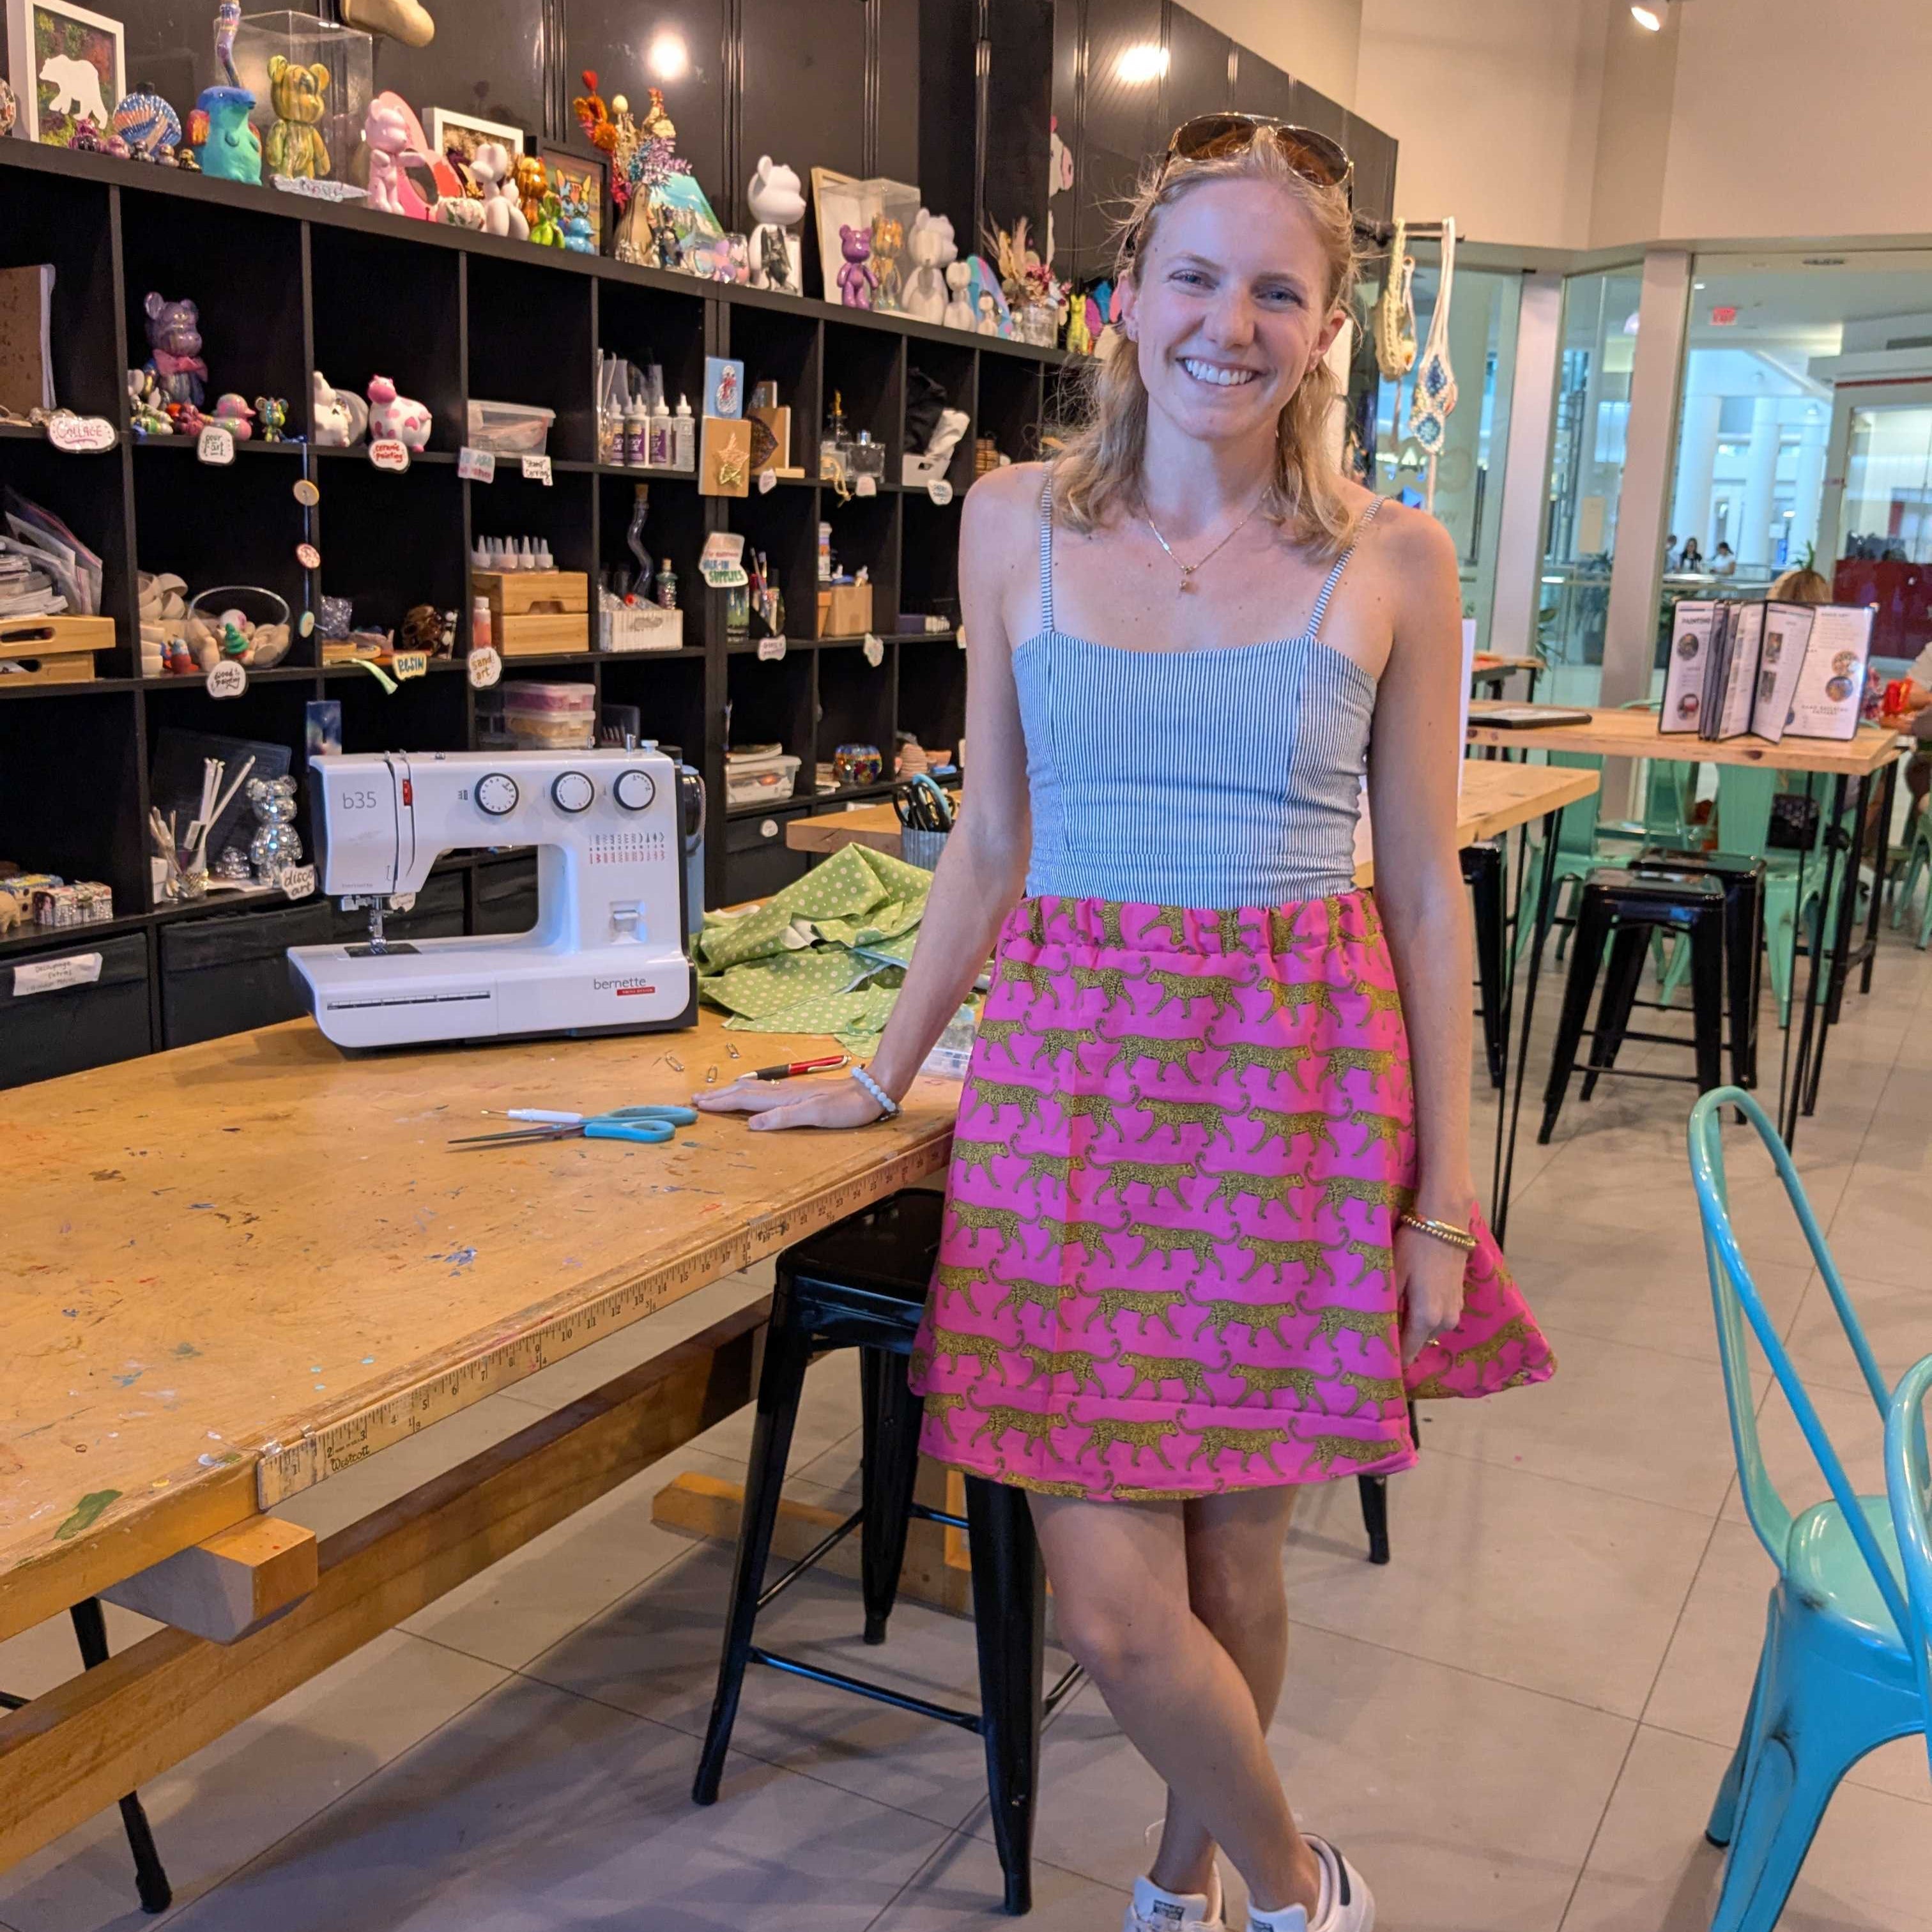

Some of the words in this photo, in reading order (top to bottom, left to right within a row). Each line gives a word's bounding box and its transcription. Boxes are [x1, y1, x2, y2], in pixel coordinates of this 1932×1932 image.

[342, 791, 377, 809] b35
[284, 869, 312, 887] disco
[291, 881, 312, 897] art
[594, 977, 646, 990] bernette
[326, 1446, 333, 1459] 2
[360, 1430, 366, 1441] 3
[422, 1399, 428, 1411] 5
[452, 1384, 457, 1395] 6
[480, 1370, 486, 1381] 7
[562, 1328, 572, 1342] 10
[586, 1317, 597, 1330] 11
[611, 1305, 622, 1317] 12
[634, 1293, 645, 1307] 13
[658, 1282, 668, 1295] 14
[680, 1271, 689, 1284] 15
[702, 1262, 711, 1273] 16
[722, 1250, 731, 1264] 17
[330, 1445, 370, 1472] Westcott
